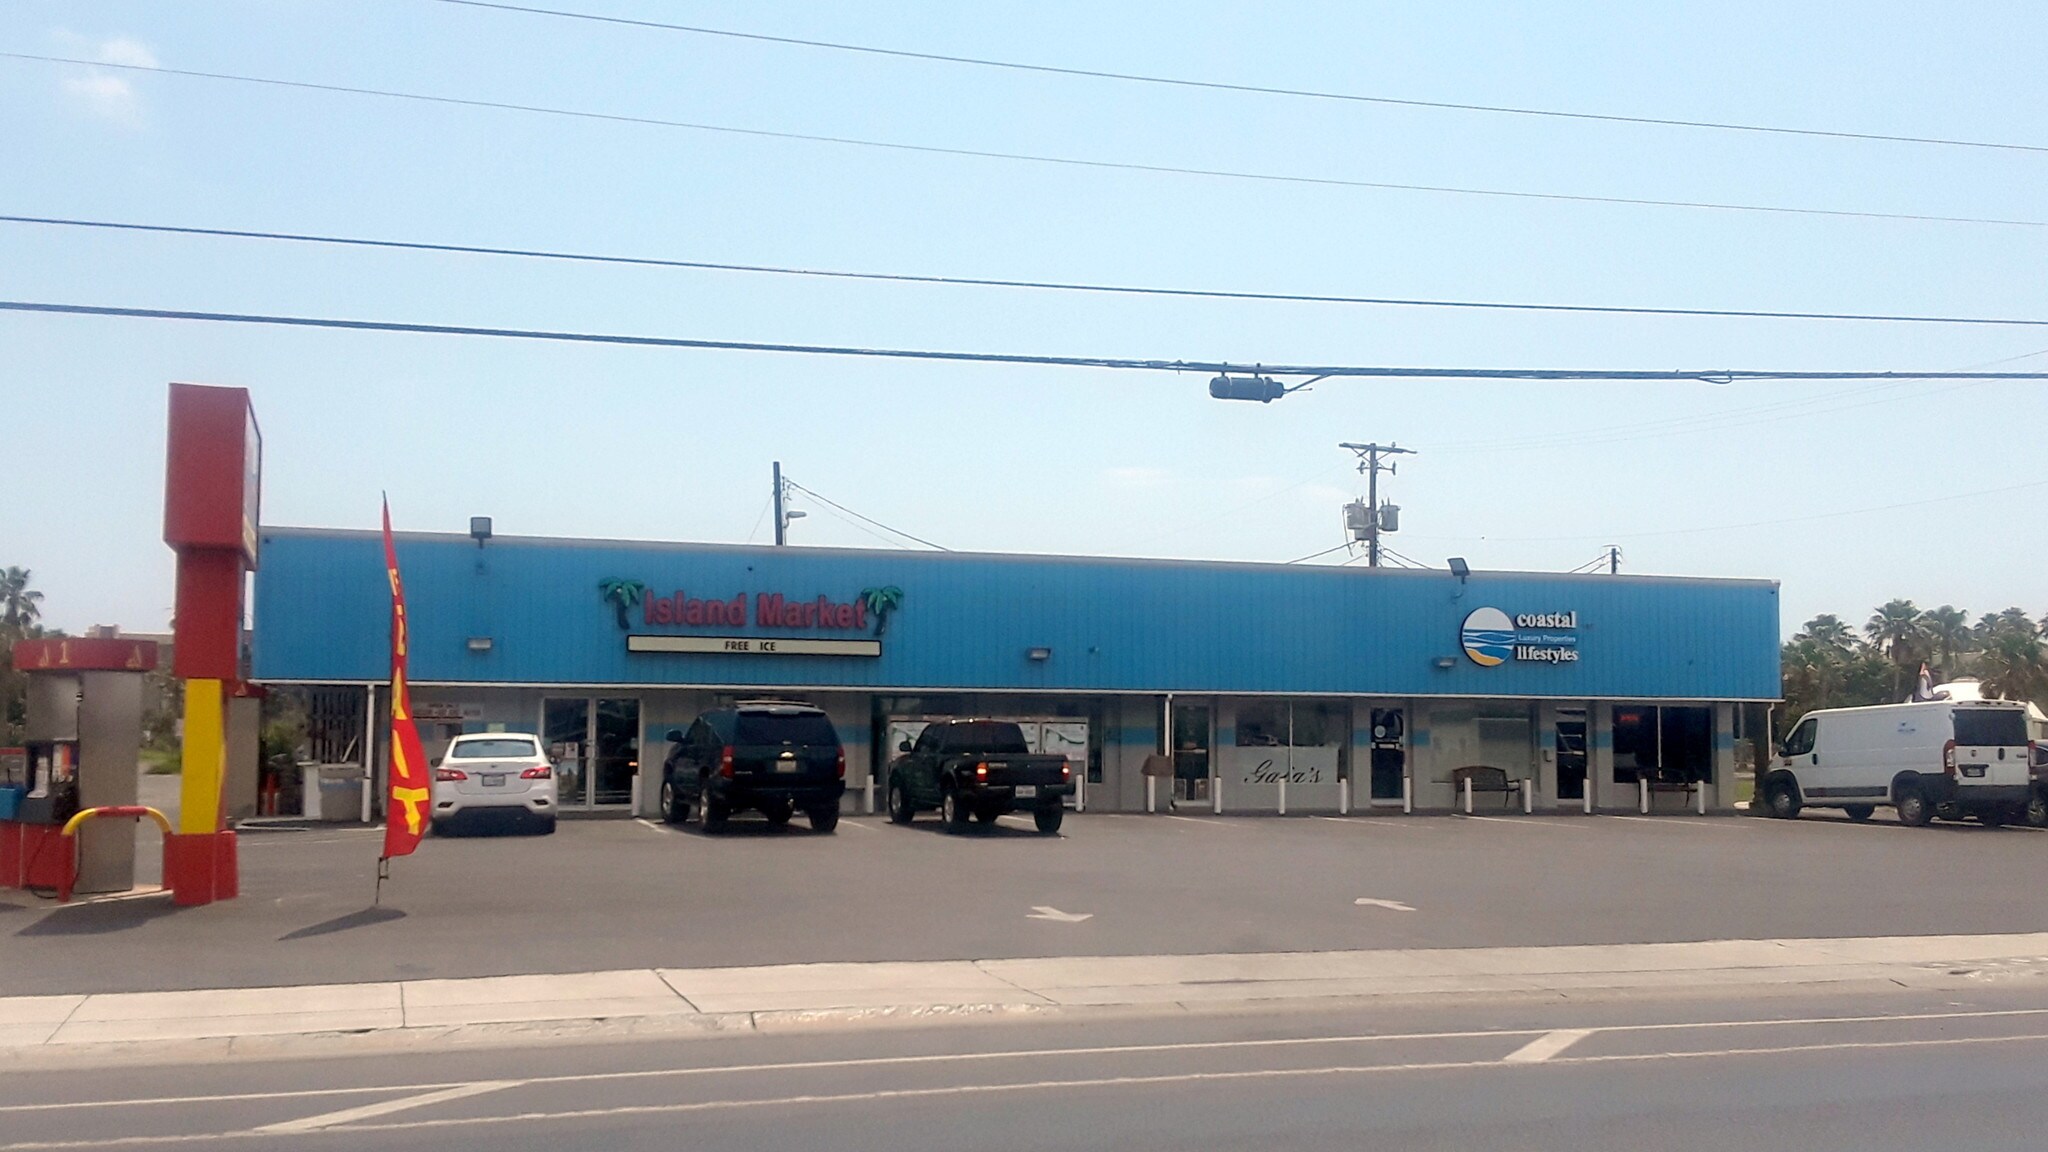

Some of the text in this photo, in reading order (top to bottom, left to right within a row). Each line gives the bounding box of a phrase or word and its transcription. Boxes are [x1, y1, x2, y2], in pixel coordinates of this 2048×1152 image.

[644, 589, 868, 628] Island Market
[1516, 611, 1576, 628] coastal
[725, 640, 777, 652] FREE ICE
[1518, 634, 1576, 643] Luxury Properties
[1517, 646, 1579, 664] lifestyles
